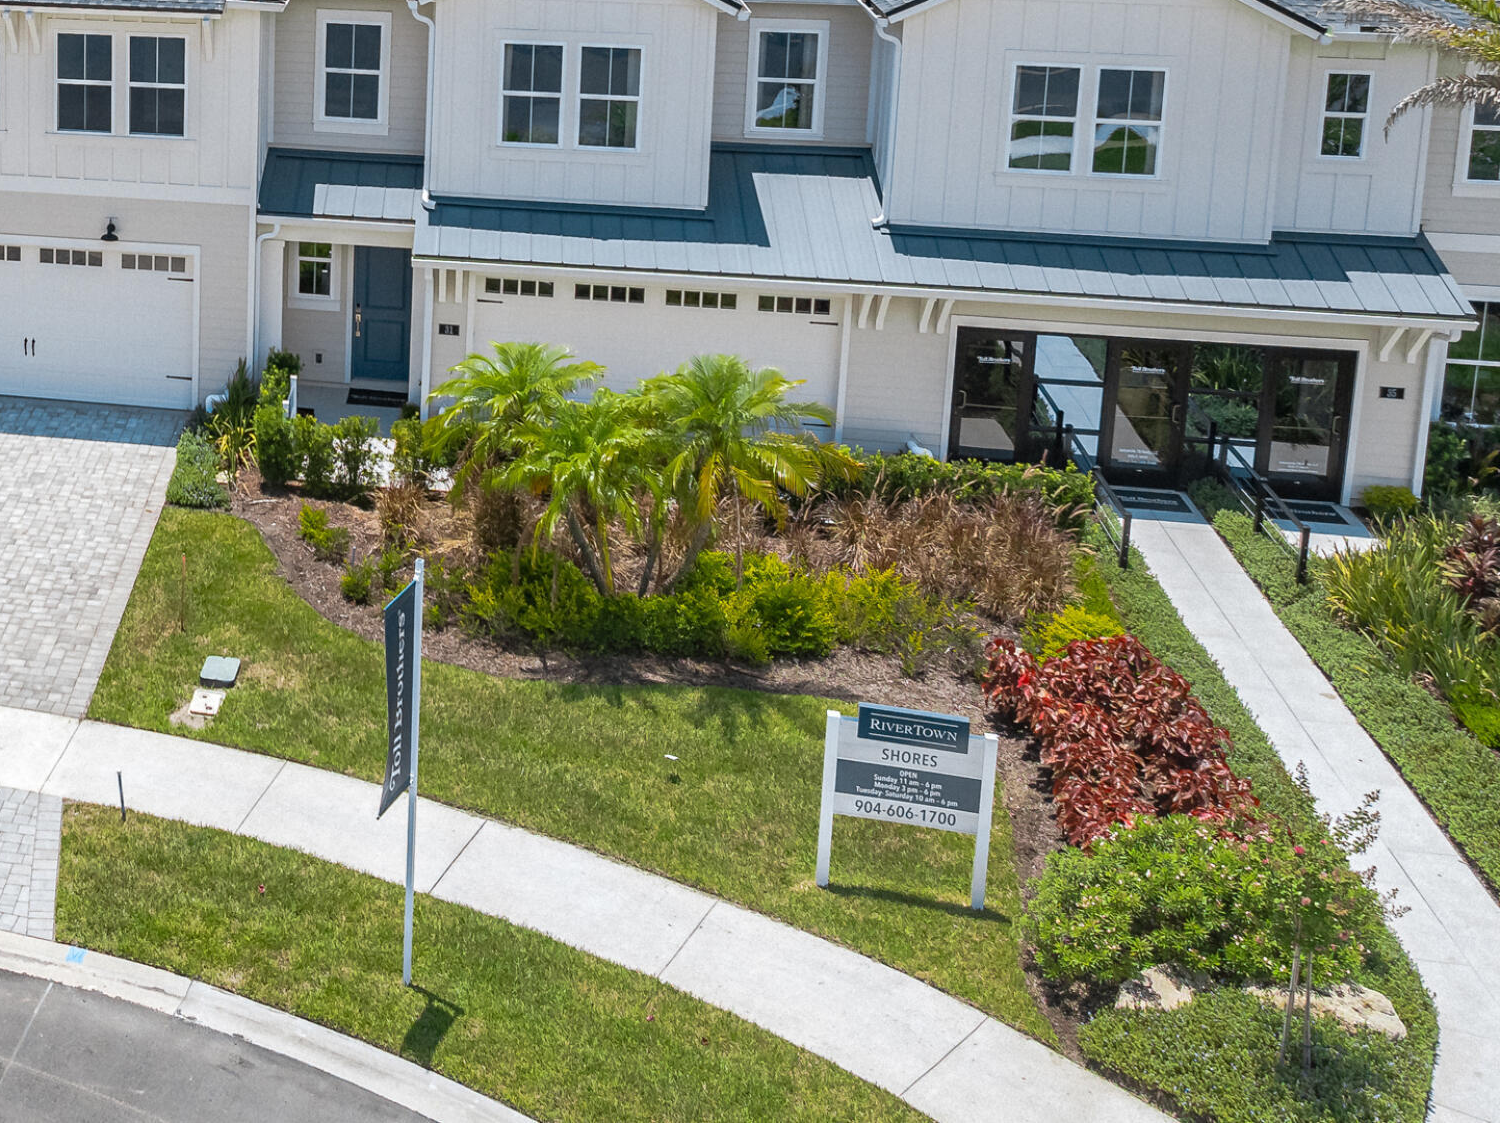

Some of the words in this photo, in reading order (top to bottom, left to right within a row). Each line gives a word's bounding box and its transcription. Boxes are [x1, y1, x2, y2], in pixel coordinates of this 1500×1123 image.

[389, 734, 402, 791] Toll
[881, 748, 938, 767] SHORES
[874, 774, 898, 784] Sunday
[899, 770, 918, 779] OPEN
[874, 781, 900, 792] Monday
[885, 790, 914, 801] Saturday
[855, 800, 957, 826] 904-606-1700
